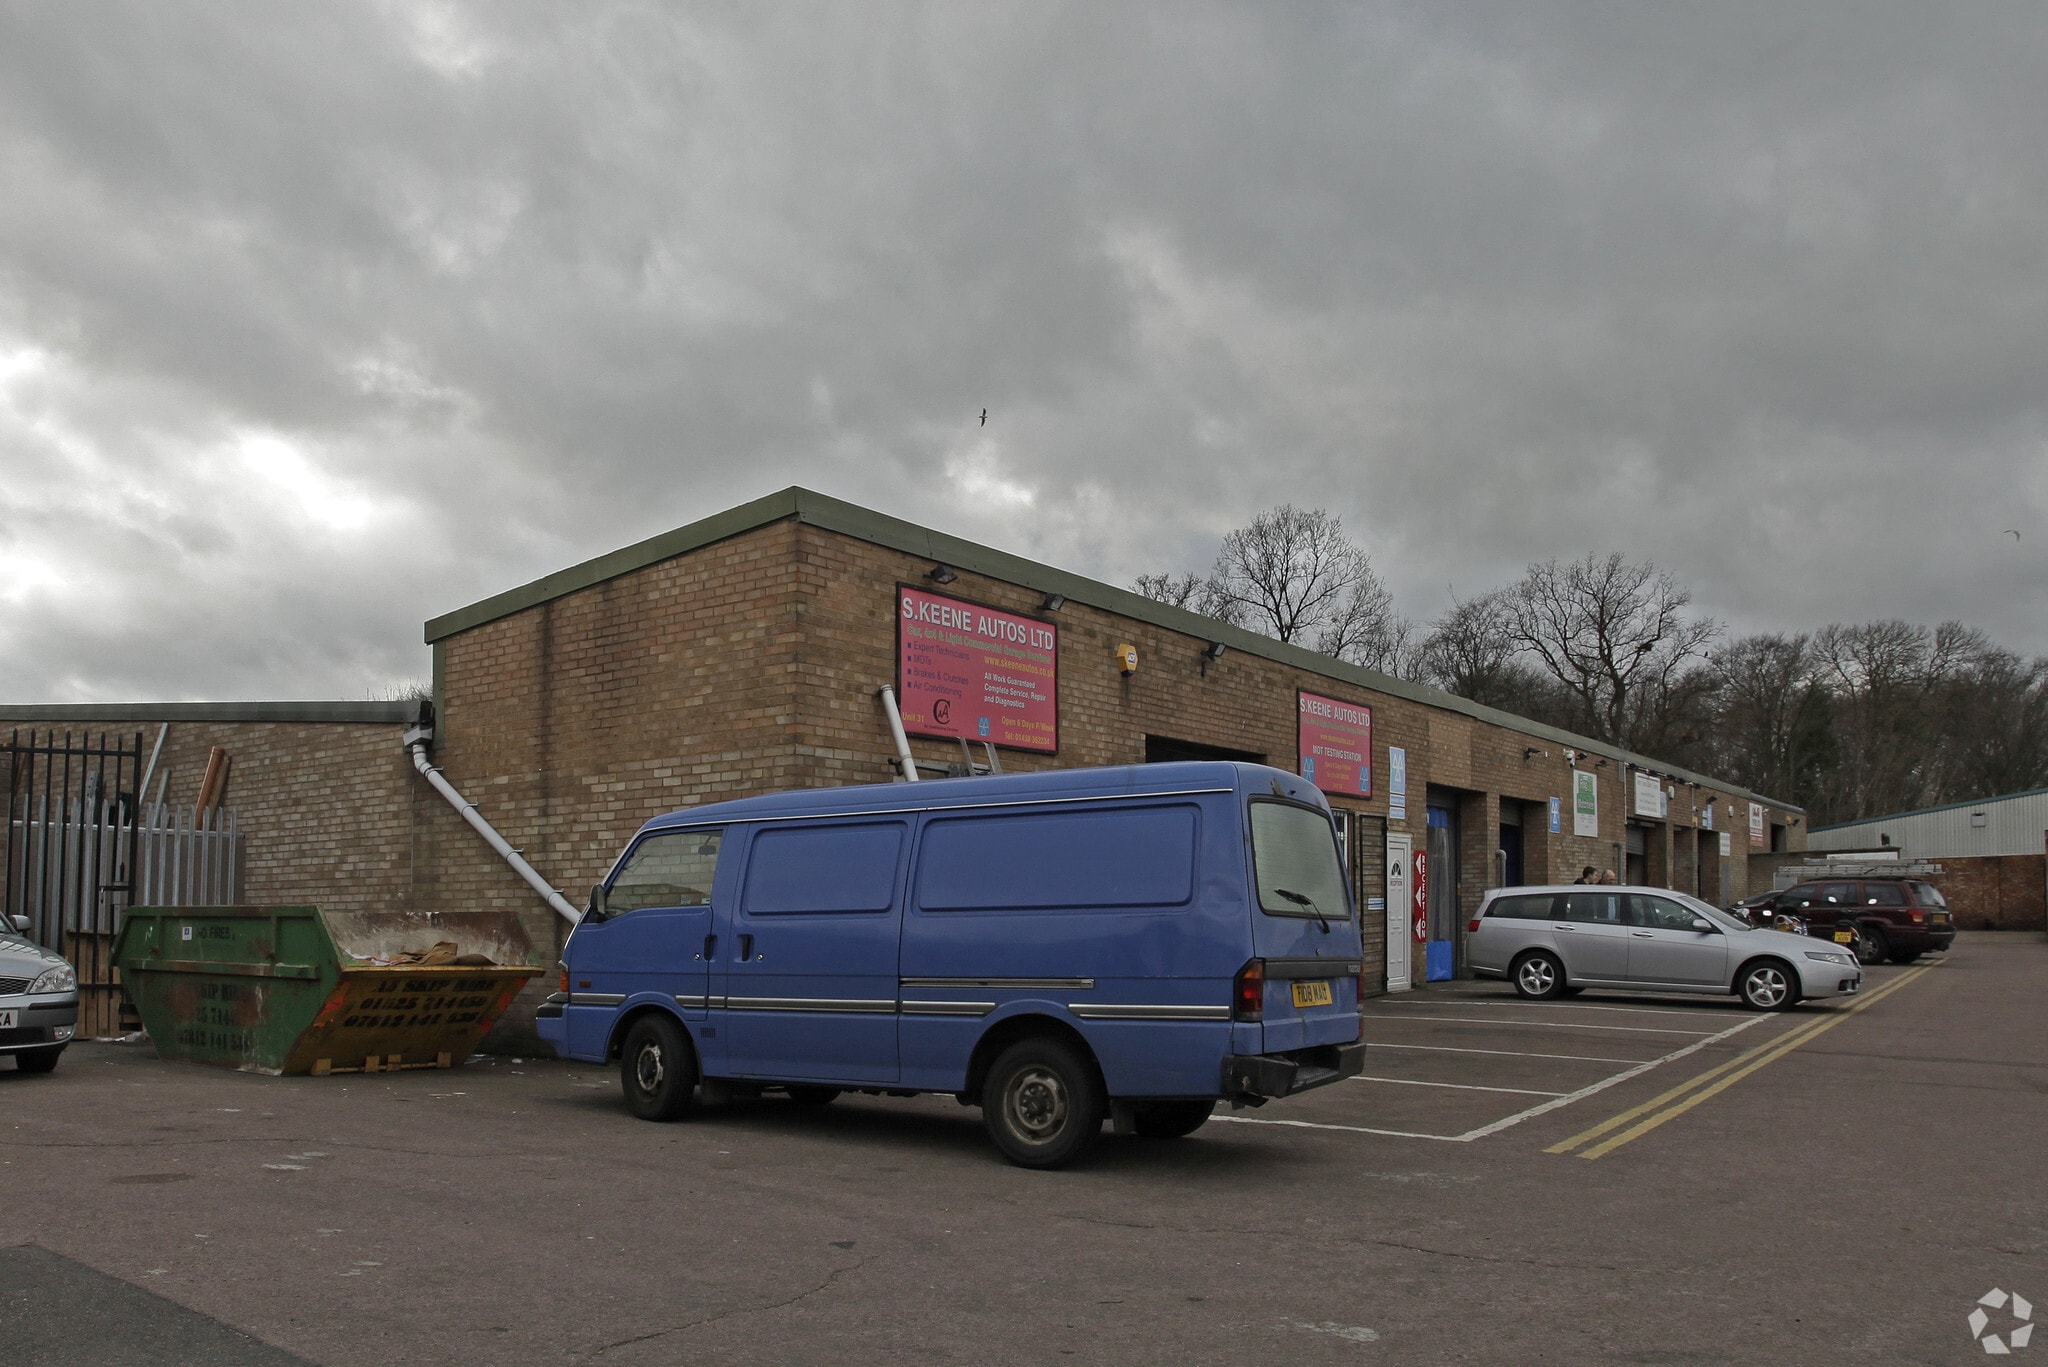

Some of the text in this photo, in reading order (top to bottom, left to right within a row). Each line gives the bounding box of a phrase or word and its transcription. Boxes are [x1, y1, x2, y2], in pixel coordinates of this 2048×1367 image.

[902, 598, 1054, 651] S.KEENE AUTOS LTD
[913, 641, 970, 661] Expert Technicians
[913, 667, 969, 685] Brakes & Clutches
[984, 672, 1036, 688] All Work Guaranteed
[913, 681, 963, 699] Air Conditioning
[984, 683, 1009, 694] Complete
[1030, 692, 1047, 702] Repair
[995, 696, 1025, 708] Diagnostics
[902, 711, 924, 723] Unit 31
[1299, 698, 1332, 718] S.KEENE
[1334, 706, 1357, 724] AUTOS
[1358, 713, 1370, 727] LTD
[1001, 716, 1016, 727] Open
[1021, 720, 1034, 730] Days
[1004, 731, 1014, 740] Tel:
[1312, 744, 1362, 762] MOT TESTING STATION
[209, 926, 231, 940] FIRES
